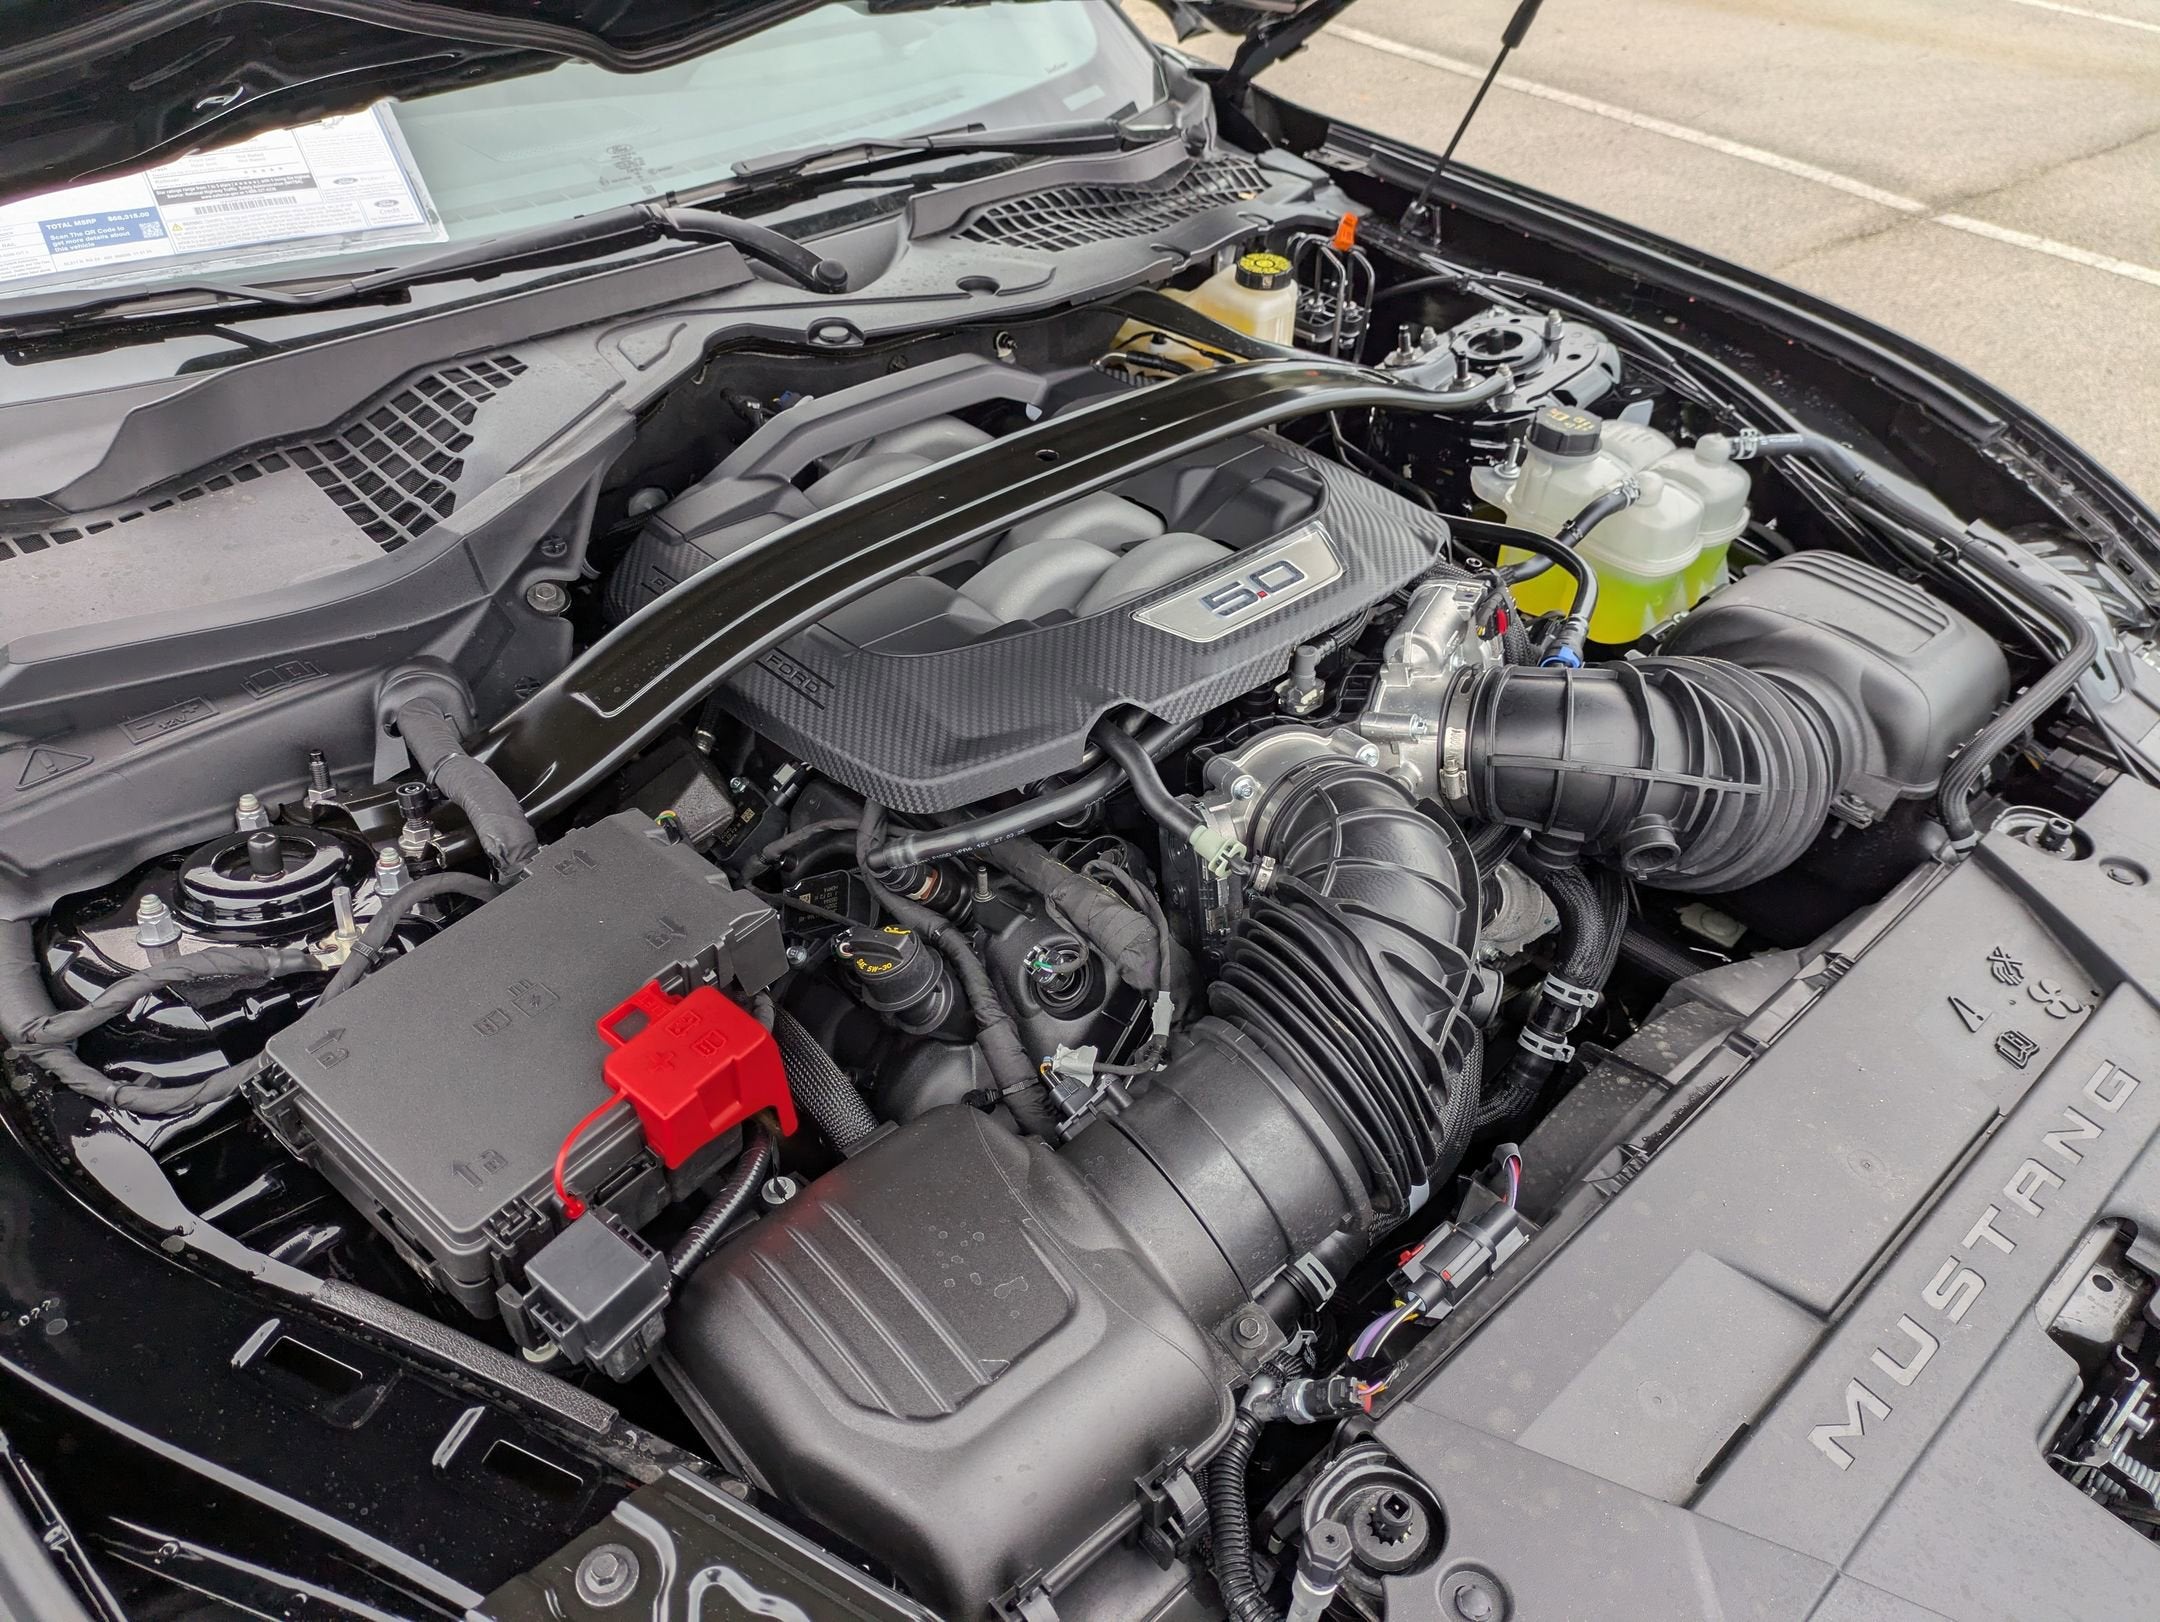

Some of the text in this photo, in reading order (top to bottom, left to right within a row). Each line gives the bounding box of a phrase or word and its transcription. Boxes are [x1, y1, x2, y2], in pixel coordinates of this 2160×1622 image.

[46, 221, 72, 231] TOTAL
[74, 218, 97, 227] MSRP
[85, 228, 97, 236] QR
[97, 226, 116, 235] Code
[1200, 560, 1306, 619] 5.0
[766, 655, 820, 694] FORD
[867, 962, 893, 973] 5W-30
[1807, 1059, 2141, 1471] MUSTANG
